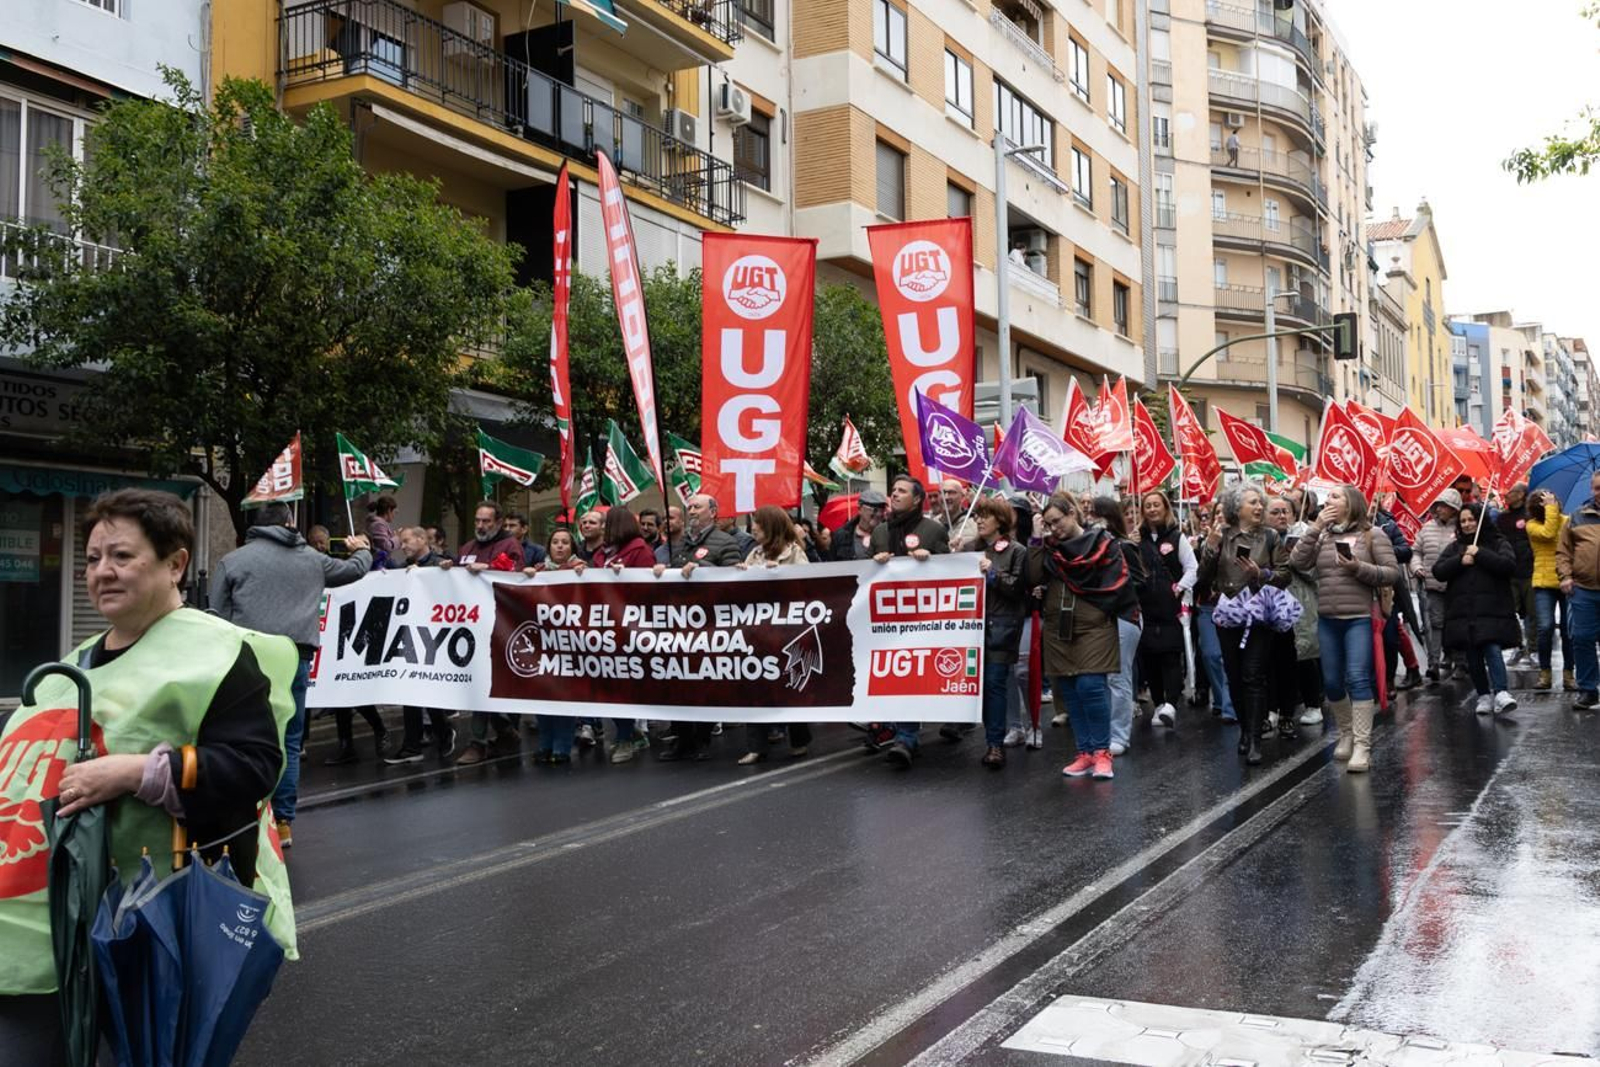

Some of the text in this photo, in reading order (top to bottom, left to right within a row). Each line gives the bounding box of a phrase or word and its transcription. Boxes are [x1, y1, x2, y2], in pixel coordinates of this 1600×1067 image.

[732, 265, 778, 291] UGT
[901, 250, 941, 278] UGT
[897, 307, 962, 484] UG
[717, 328, 787, 512] UGT
[1395, 431, 1433, 475] UGT
[430, 603, 479, 624] 2024
[536, 600, 832, 628] POR EL PLENO EMPLEO:
[876, 586, 957, 614] CCOO
[872, 619, 983, 635] unión provincial de Jaén
[540, 630, 754, 655] MENOS JORNADA,
[538, 655, 780, 680] MEJORES SALARIOS
[872, 649, 932, 678] UGT
[941, 678, 978, 693] Jaén
